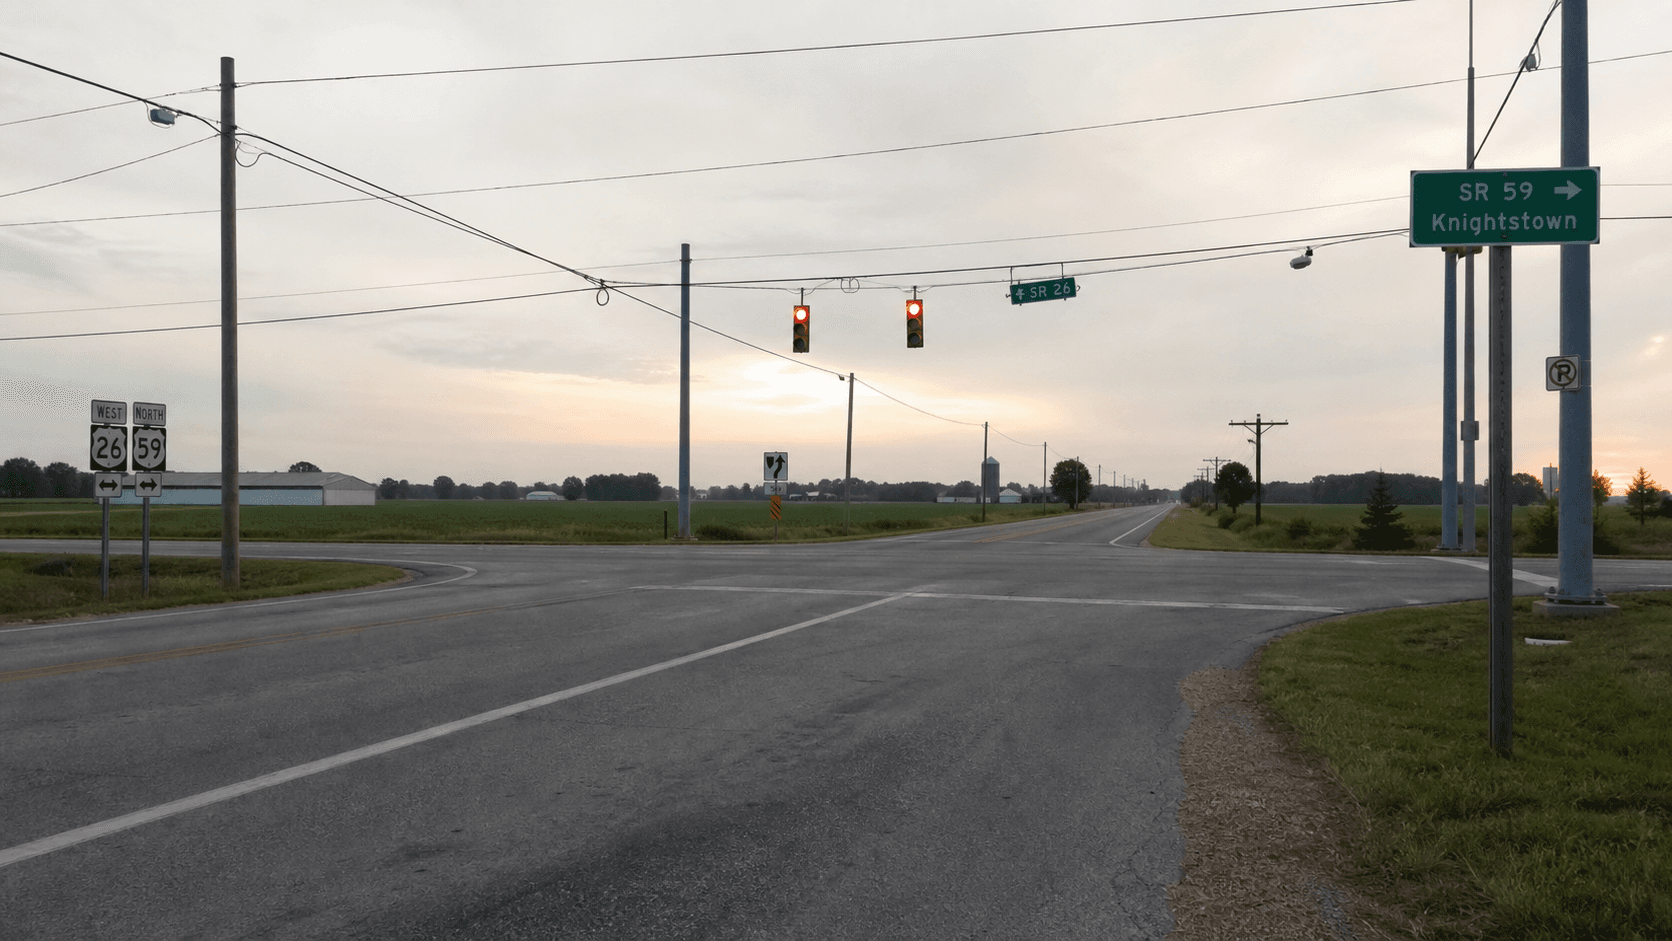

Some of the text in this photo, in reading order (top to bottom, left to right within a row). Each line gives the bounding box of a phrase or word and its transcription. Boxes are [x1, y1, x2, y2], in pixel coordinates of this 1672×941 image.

[1459, 181, 1533, 201] SR 59
[1432, 212, 1577, 236] Knightstown
[1030, 282, 1071, 299] SR 26
[96, 405, 122, 420] WEST
[135, 407, 164, 421] NORTH
[96, 436, 122, 459] 26
[138, 437, 161, 459] 59
